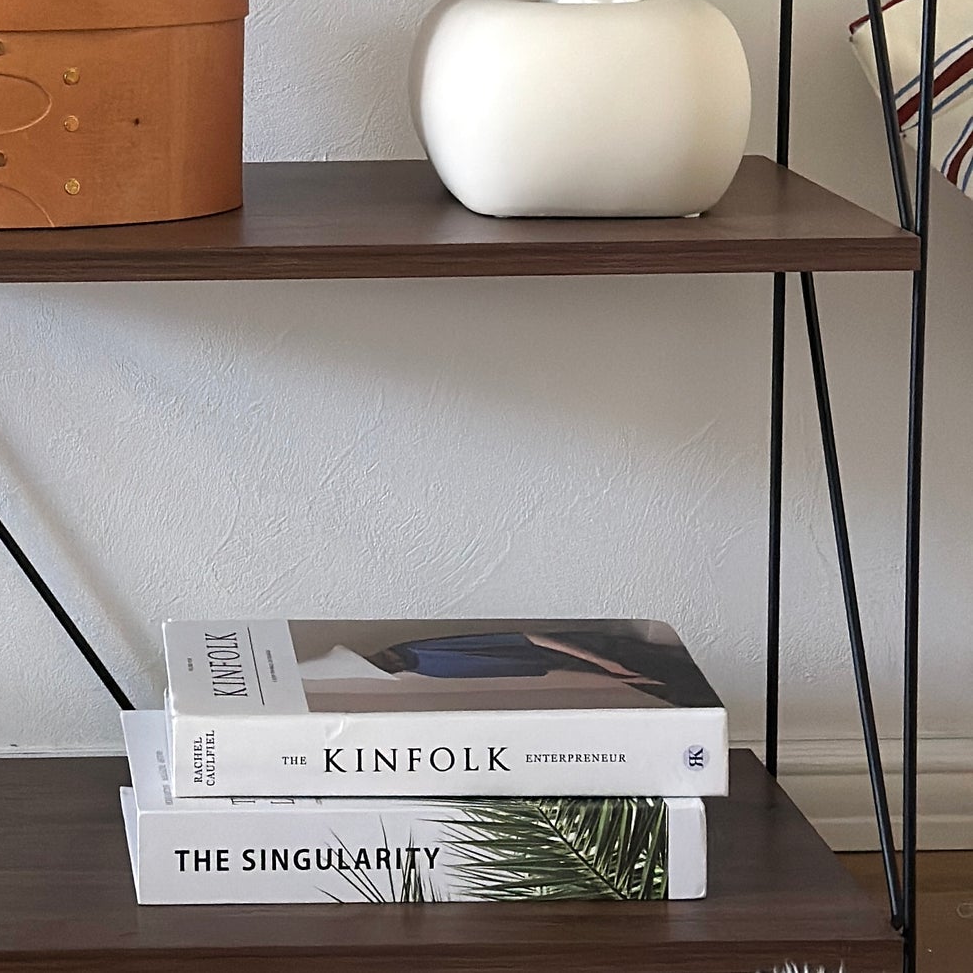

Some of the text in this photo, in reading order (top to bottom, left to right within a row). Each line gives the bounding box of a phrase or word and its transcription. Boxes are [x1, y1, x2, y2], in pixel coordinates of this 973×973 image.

[205, 632, 248, 697] KINFOLK
[193, 736, 203, 783] RACHEL
[206, 729, 216, 787] CAULFIEL
[281, 746, 627, 773] THE KINFOLK ENTERPRENEUR
[174, 846, 441, 872] THE SINGULARITY
